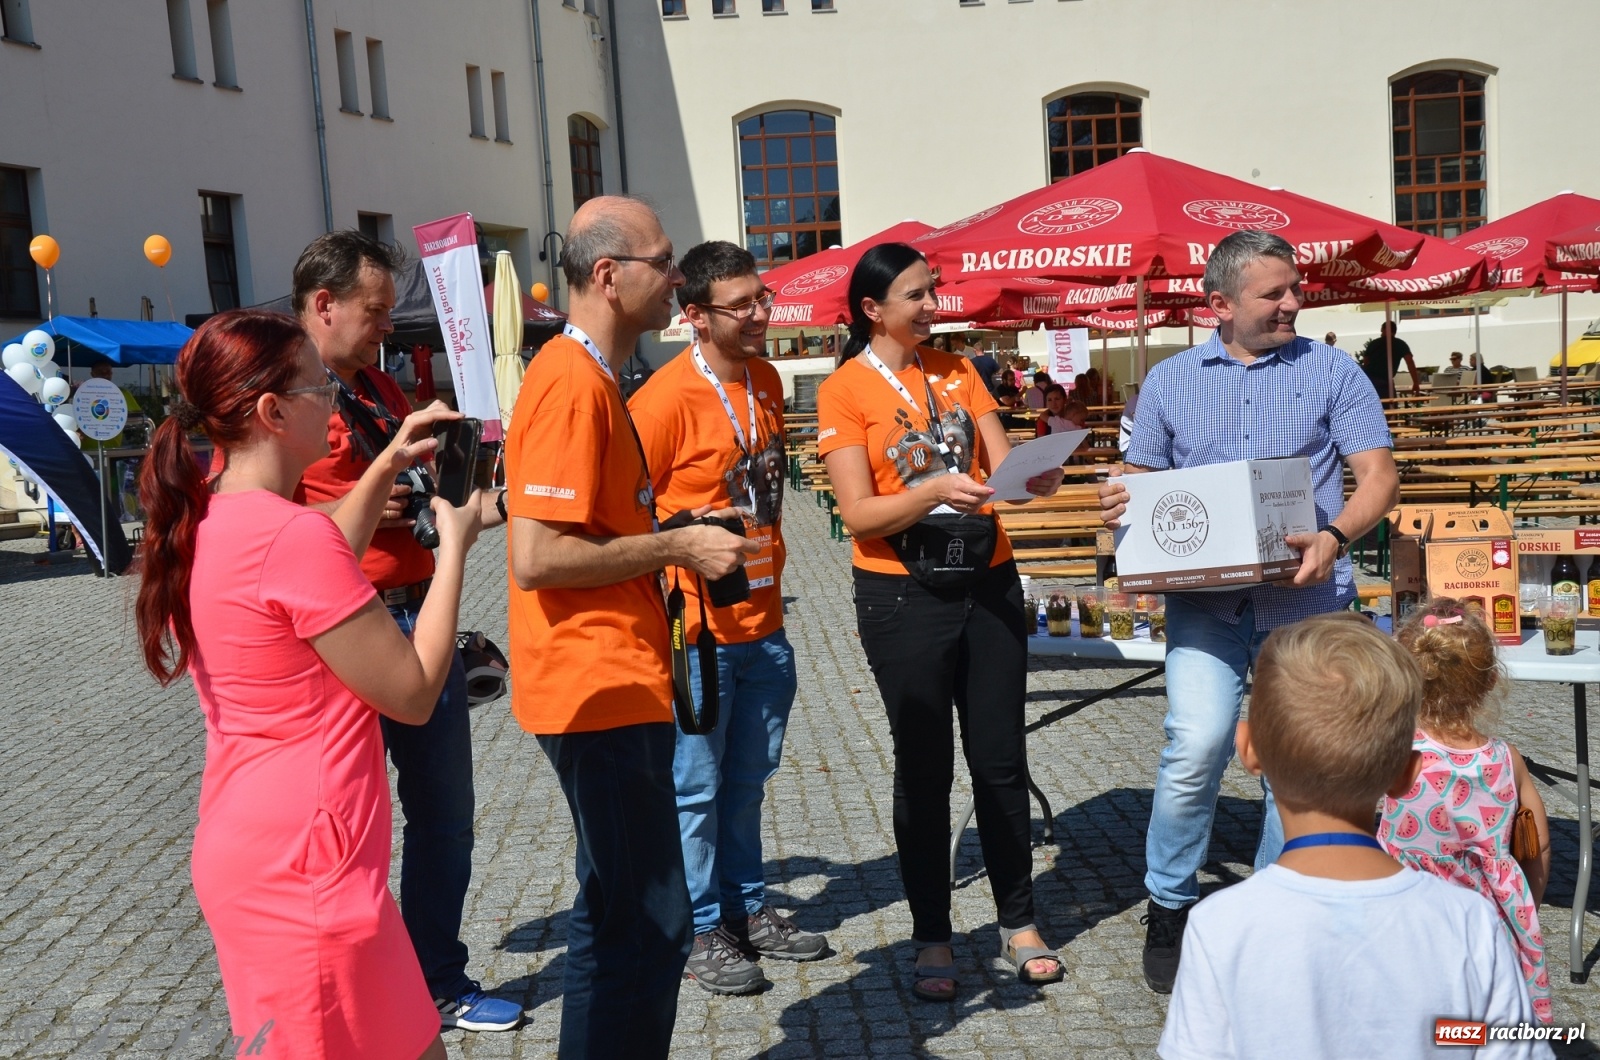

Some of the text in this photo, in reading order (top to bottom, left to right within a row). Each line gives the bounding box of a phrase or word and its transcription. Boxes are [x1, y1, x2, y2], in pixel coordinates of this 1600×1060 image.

[961, 243, 1132, 273] RACIBORSKIE
[1065, 281, 1138, 305] RACIBORSKIE
[525, 483, 576, 496] INDUSTRIADA
[1182, 518, 1204, 533] 1567
[1123, 578, 1153, 587] RACIBORSKIE
[1221, 570, 1254, 579] RACIBORSKIE
[1444, 580, 1500, 590] RACIBORSKIE
[673, 618, 681, 650] Nikon
